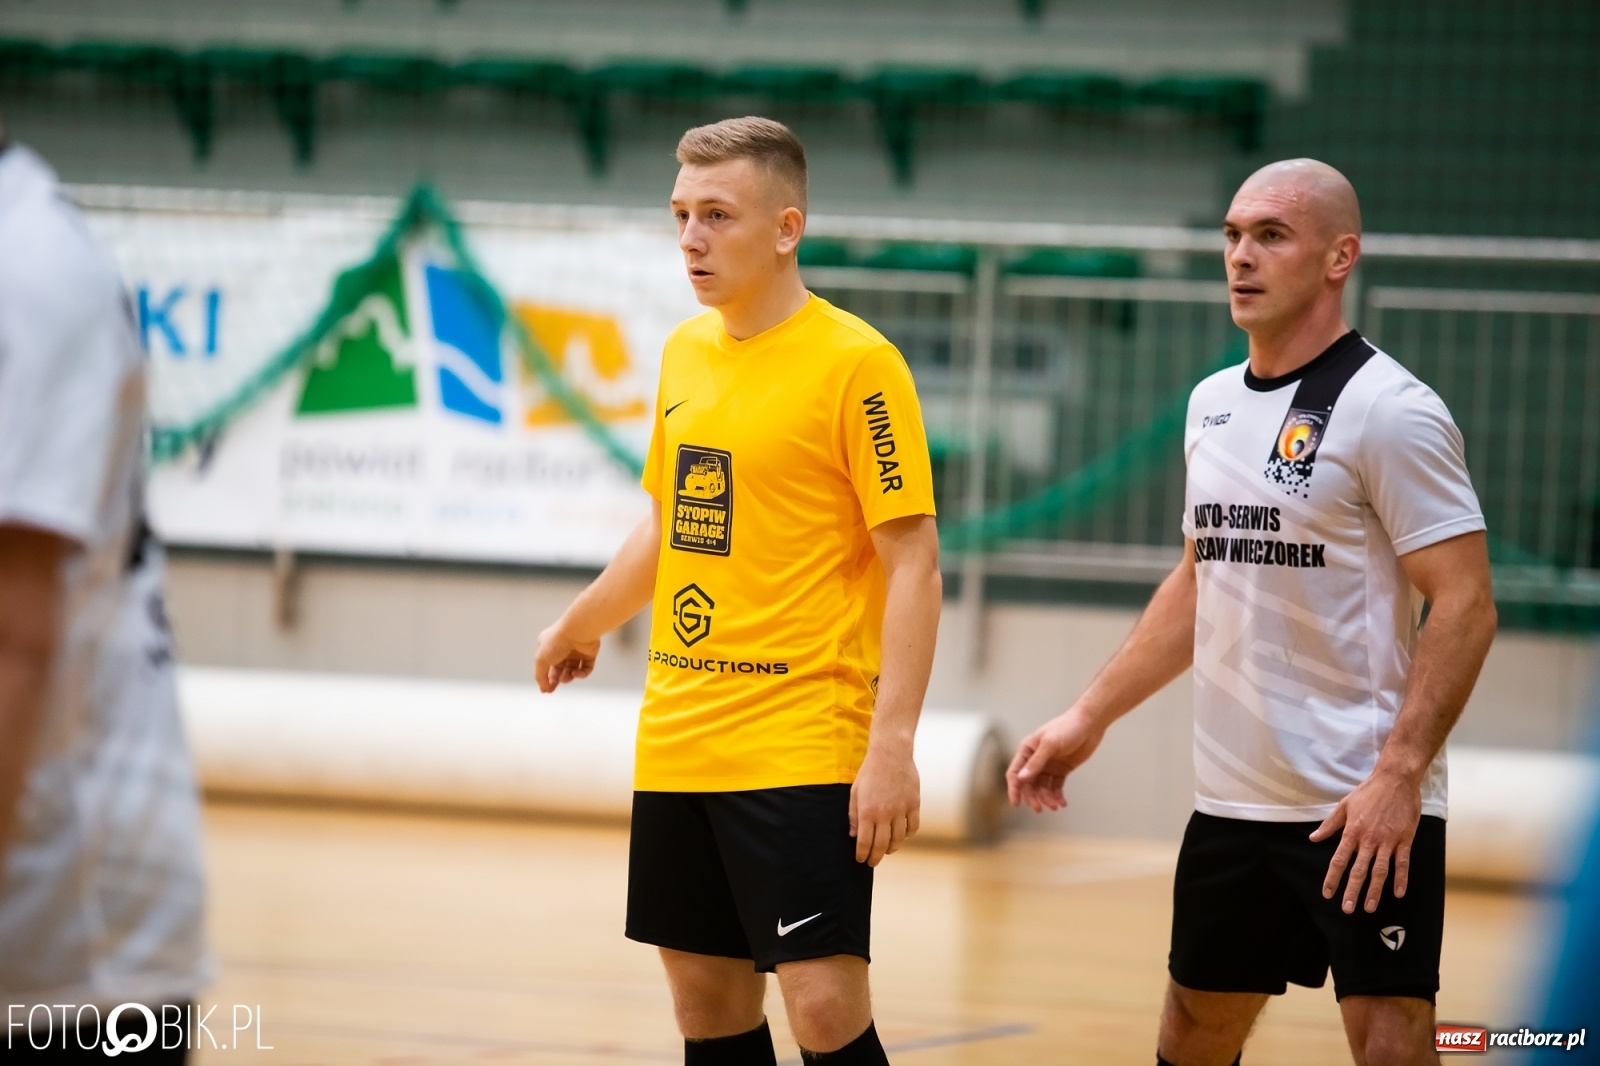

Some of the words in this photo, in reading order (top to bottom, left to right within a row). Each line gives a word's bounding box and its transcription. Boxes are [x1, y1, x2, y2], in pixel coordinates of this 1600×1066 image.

[862, 391, 903, 495] WINDAR
[677, 504, 726, 525] STOPIW
[1194, 503, 1281, 532] AUTO-SERWIS
[675, 519, 725, 540] GARAGE
[680, 534, 705, 544] SERWIS
[1230, 538, 1326, 568] WIECZOREK
[653, 651, 789, 675] PRODUCTIONS
